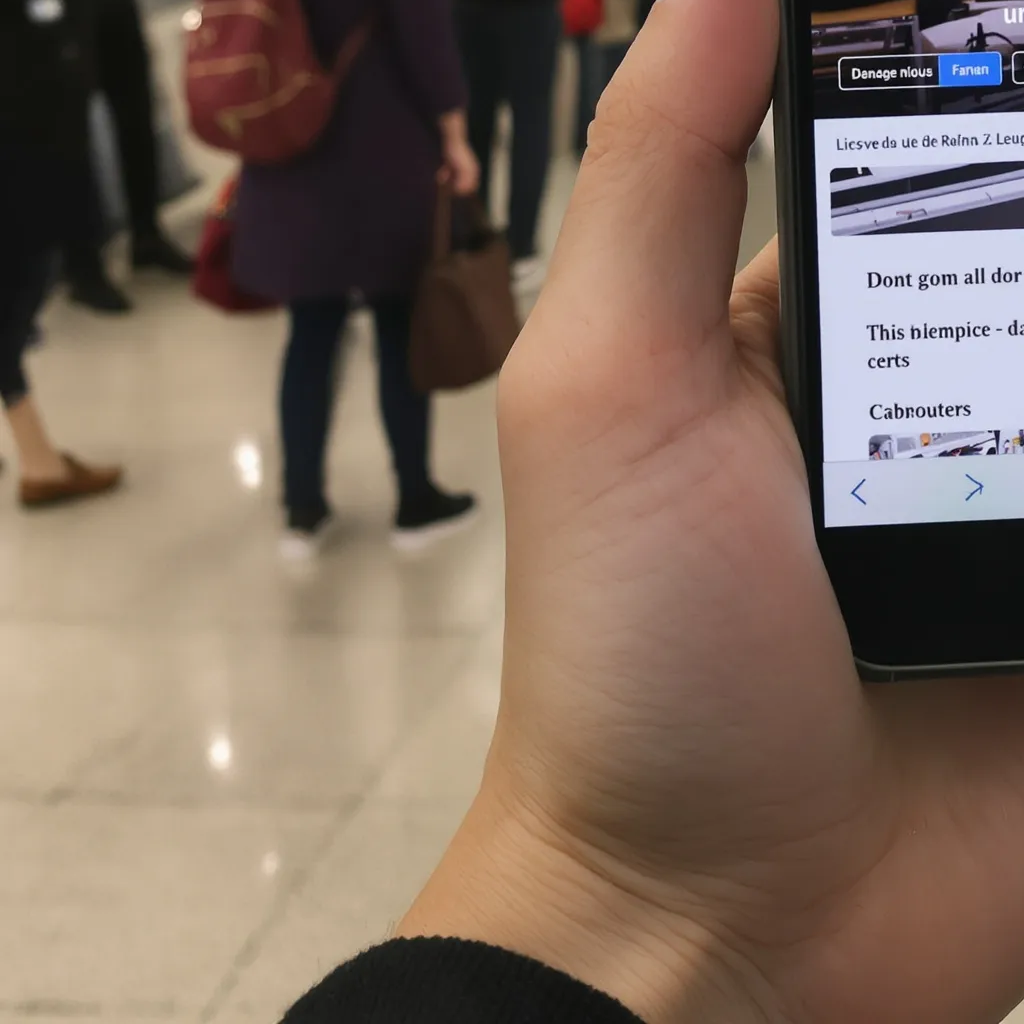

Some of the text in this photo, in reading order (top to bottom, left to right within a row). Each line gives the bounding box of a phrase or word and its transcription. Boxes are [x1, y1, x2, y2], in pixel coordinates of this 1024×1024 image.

[867, 272, 913, 289] Dont
[918, 273, 958, 291] gom
[964, 267, 985, 285] all
[991, 267, 1022, 283] dor
[866, 324, 905, 341] This
[867, 353, 910, 369] certs
